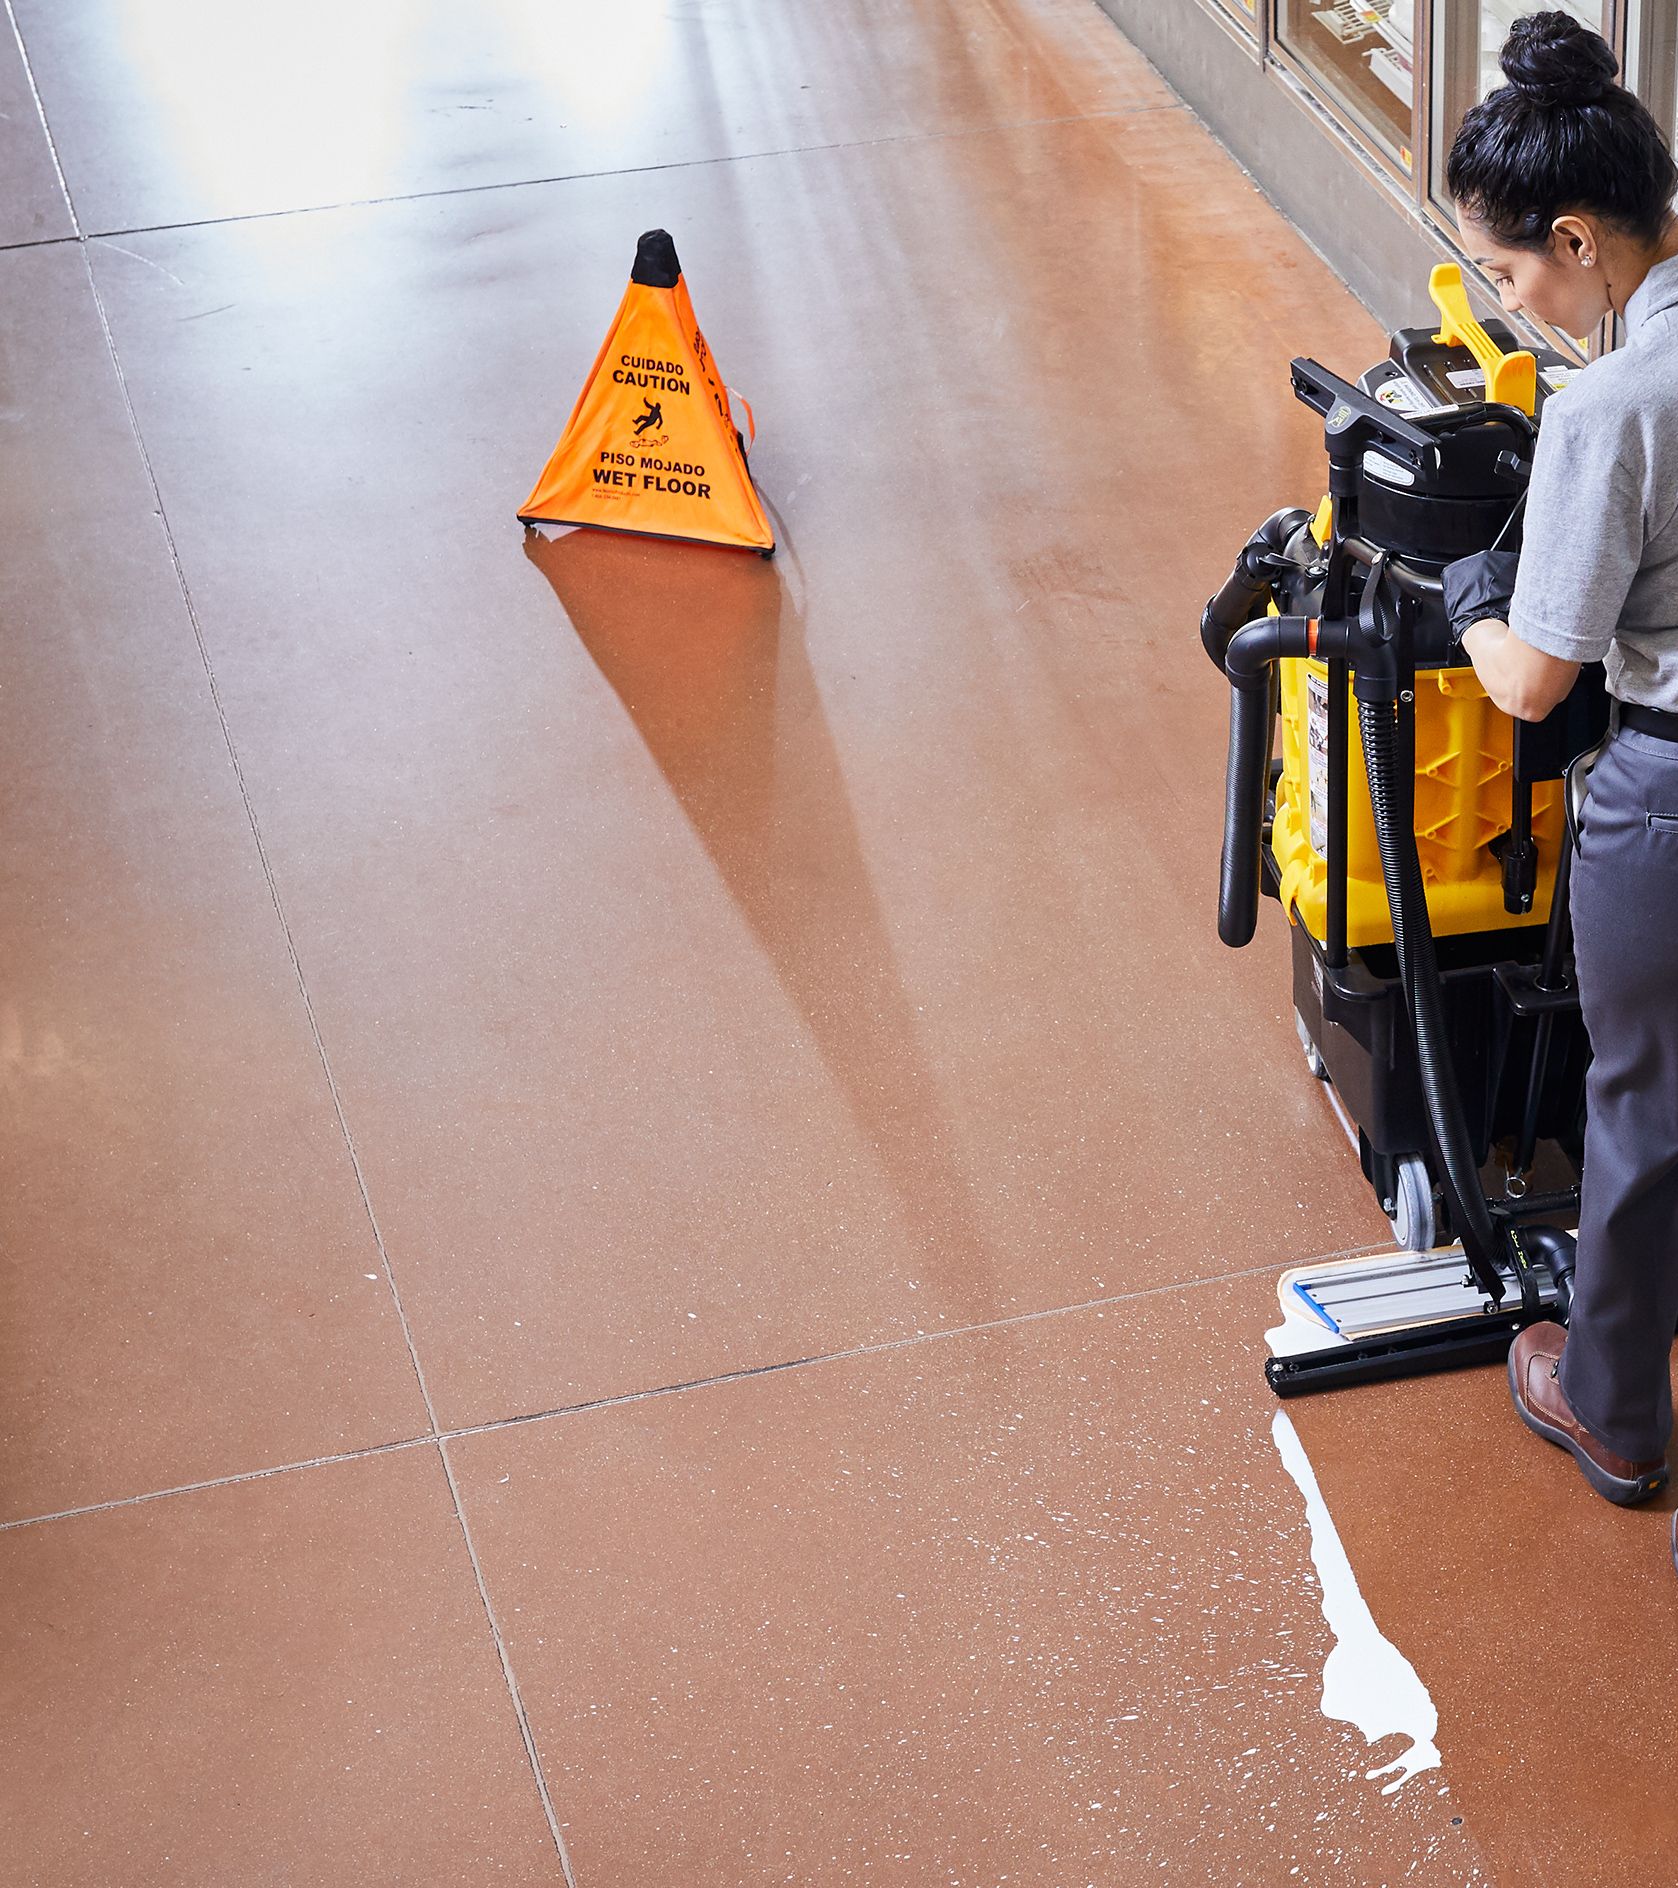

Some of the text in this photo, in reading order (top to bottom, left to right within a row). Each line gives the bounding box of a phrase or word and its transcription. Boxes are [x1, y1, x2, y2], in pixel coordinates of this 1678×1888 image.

[621, 354, 684, 376] CUIDADO
[612, 369, 690, 395] CAUTION
[600, 451, 705, 477] PISO MOJADO
[593, 468, 637, 488] WET
[643, 475, 711, 500] FLOOR
